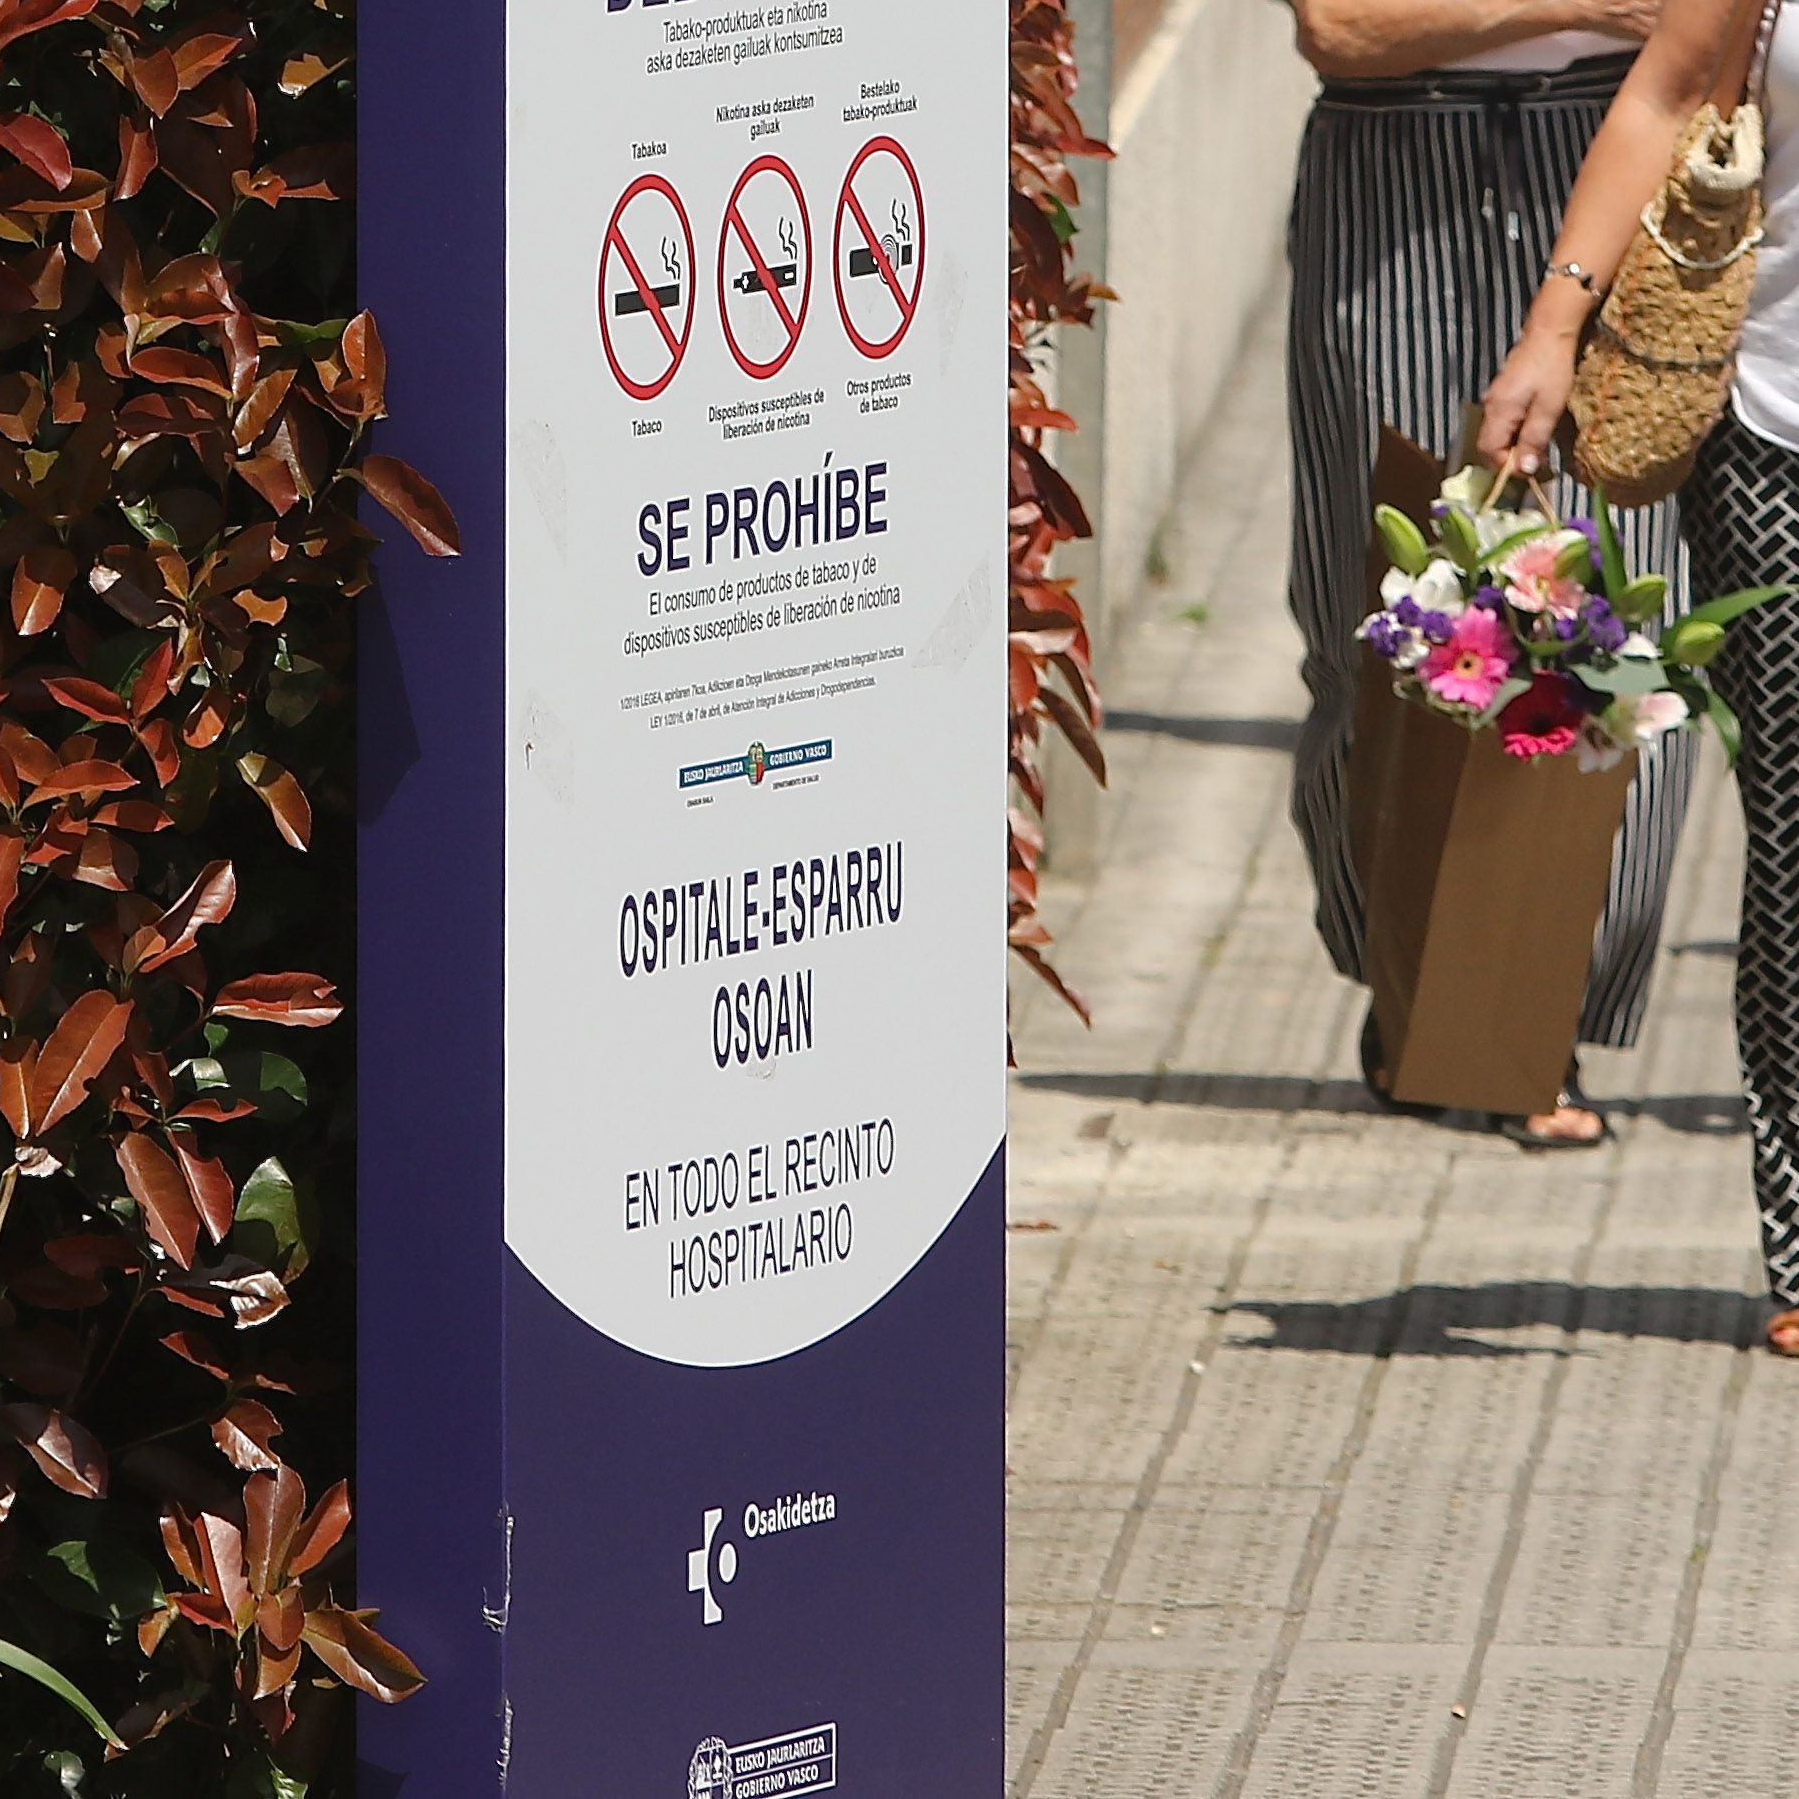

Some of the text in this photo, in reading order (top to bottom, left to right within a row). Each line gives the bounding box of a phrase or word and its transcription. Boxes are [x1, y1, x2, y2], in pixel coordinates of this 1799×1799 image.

[663, 0, 828, 43] Tabako-produktuak eta nikotina
[647, 26, 843, 74] aska dezaketen gailuak kontsumitzea
[860, 81, 899, 99] Bestelako
[716, 96, 814, 122] Nikotina aska dezaketen
[843, 97, 918, 122] tabako-produktuak
[750, 120, 780, 140] gailuak
[632, 141, 667, 160] Tabakoa
[847, 374, 911, 396] Otros productos
[709, 388, 824, 422] Dispositivos susceptibles de
[860, 395, 898, 413] de tabaco
[632, 420, 662, 437] Tabaco
[723, 412, 810, 440] liberación de nicotina
[637, 451, 888, 576] SE PROHÍBE
[650, 553, 876, 616] El consumo de productos de tabaco y de
[624, 586, 900, 656] dispositivos susceptibles de liberación de nicotina
[770, 745, 827, 766] GOBIERNO VASCO
[619, 841, 903, 978] OSPITALE-ESPARRU
[713, 969, 814, 1068] OSOAN
[625, 1118, 895, 1231] EN TODO EL RECINTO
[669, 1203, 853, 1299] HOSPITALARIO
[745, 1490, 836, 1538] Osakidetza
[736, 1736, 825, 1773] EUSKO JAURLARITZA
[736, 1764, 818, 1799] GOBIERNO VASCO
